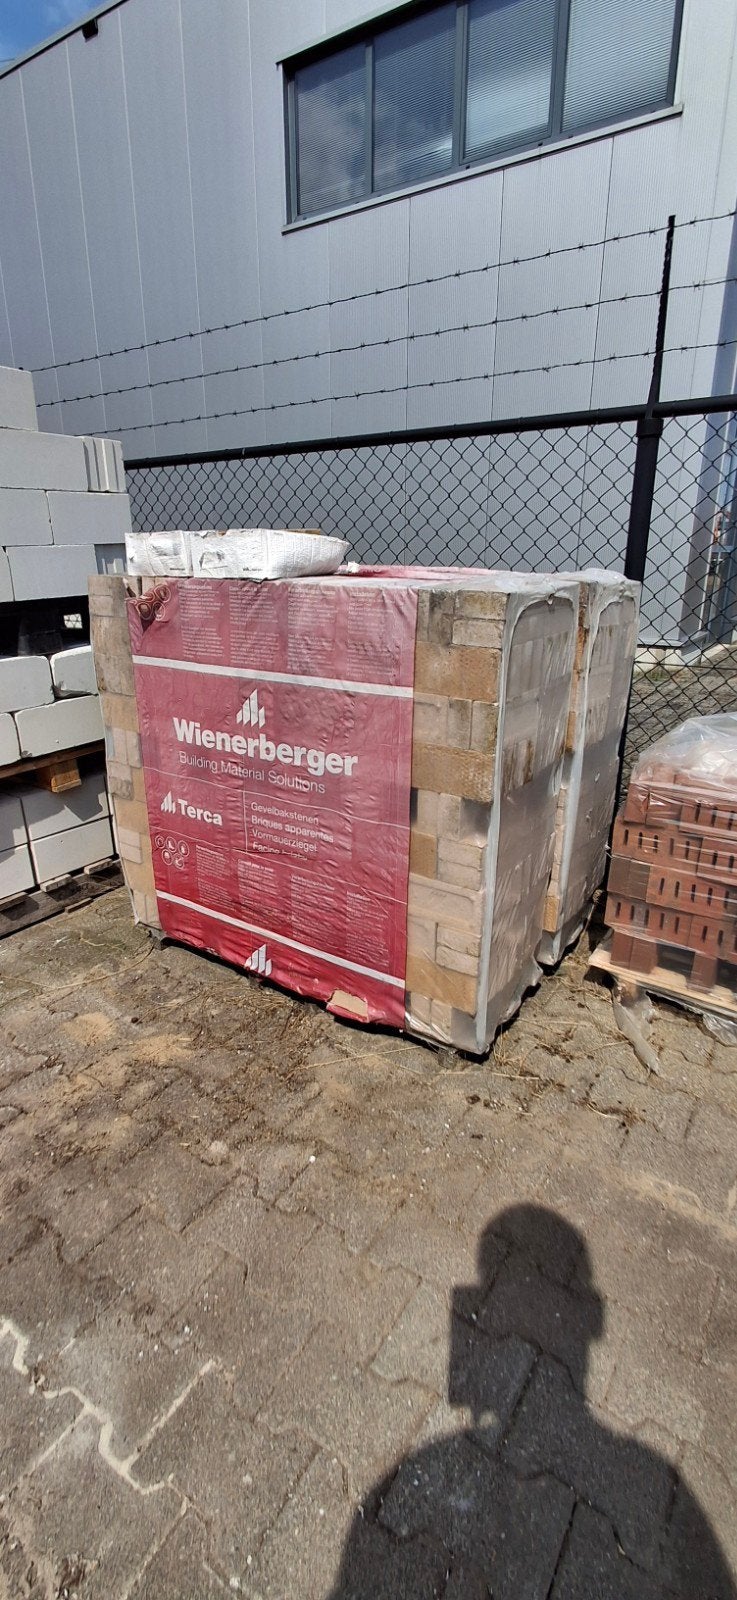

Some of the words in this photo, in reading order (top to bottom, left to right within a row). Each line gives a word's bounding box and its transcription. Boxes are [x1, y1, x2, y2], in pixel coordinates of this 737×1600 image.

[172, 717, 359, 777] Wienerberger
[179, 751, 218, 773] Building
[221, 760, 265, 780] Material
[268, 770, 326, 794] Solutions
[177, 799, 223, 826] Terca
[251, 801, 319, 825] Gevelbakstenen
[251, 815, 283, 830] Briques
[285, 823, 334, 843] apparentes
[252, 829, 318, 853] Vormauerziegel
